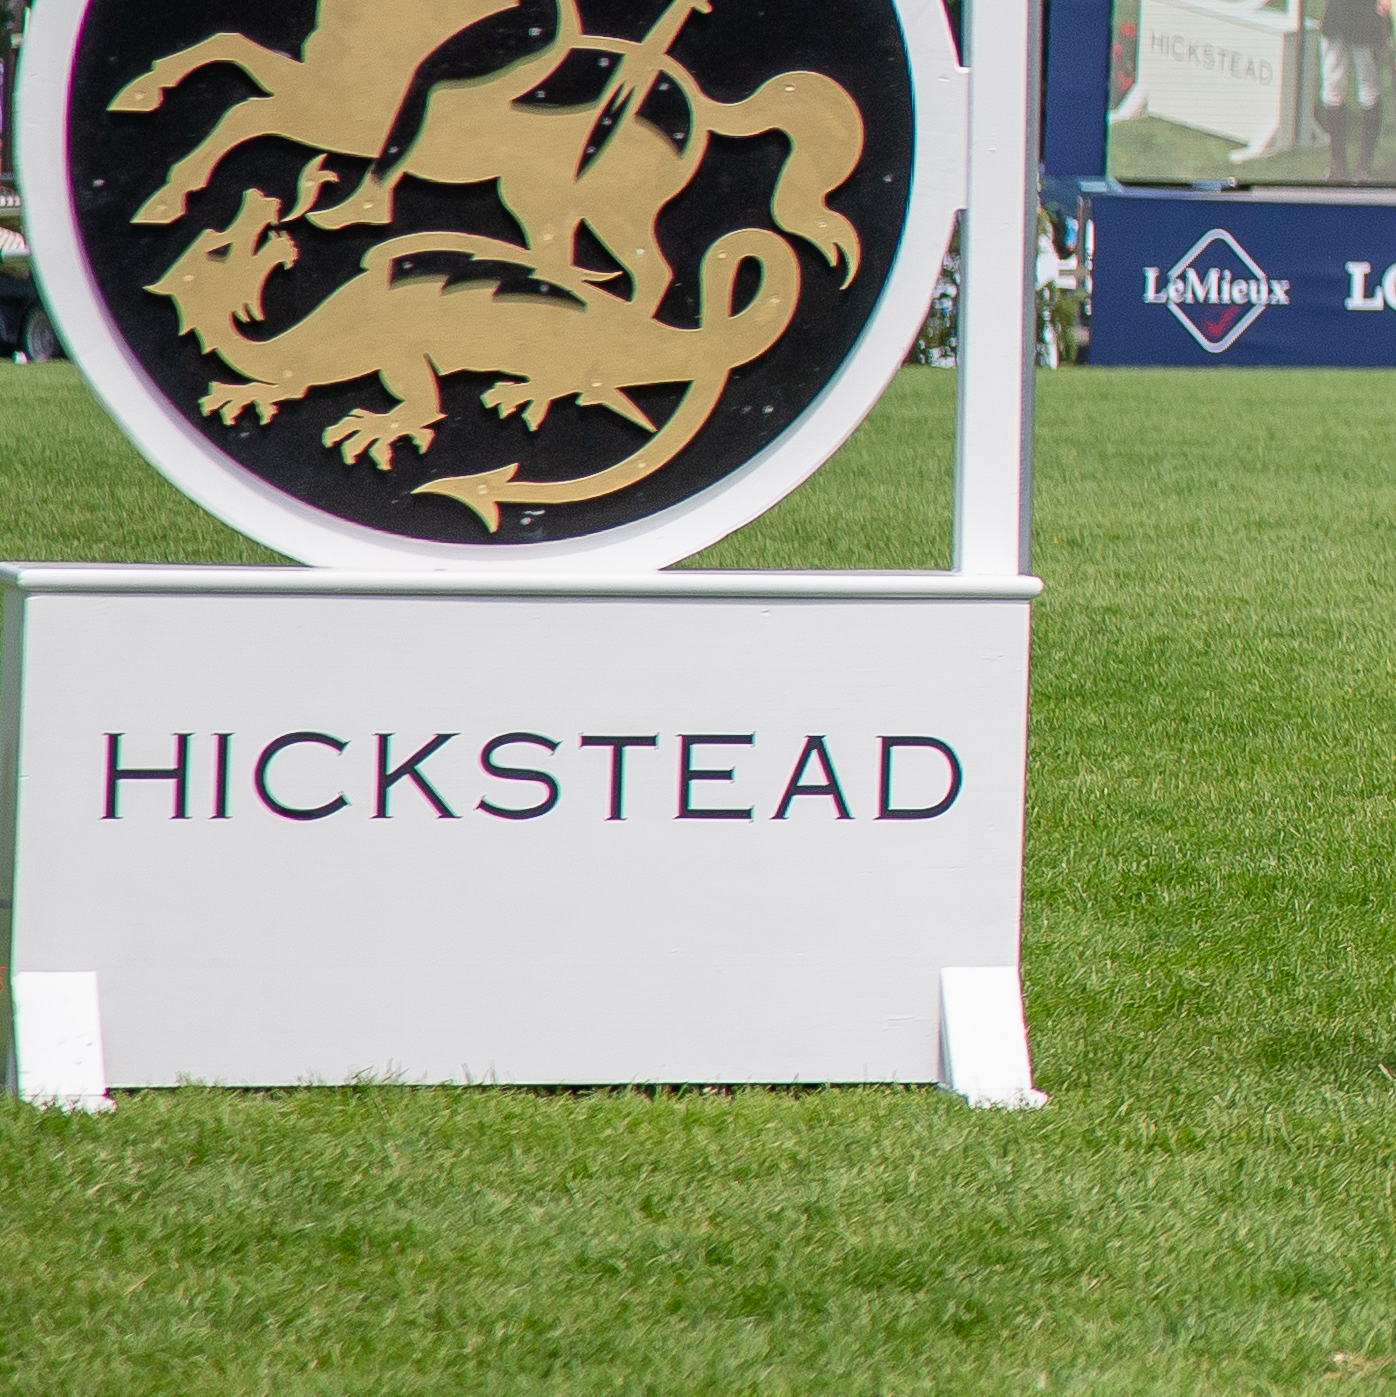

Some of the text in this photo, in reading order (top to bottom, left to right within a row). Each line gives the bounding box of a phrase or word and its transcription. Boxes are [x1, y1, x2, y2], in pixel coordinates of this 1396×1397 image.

[1150, 29, 1273, 86] HICKSTEAD
[1143, 265, 1290, 306] LeMieux
[98, 730, 965, 822] HICKSTEAD
